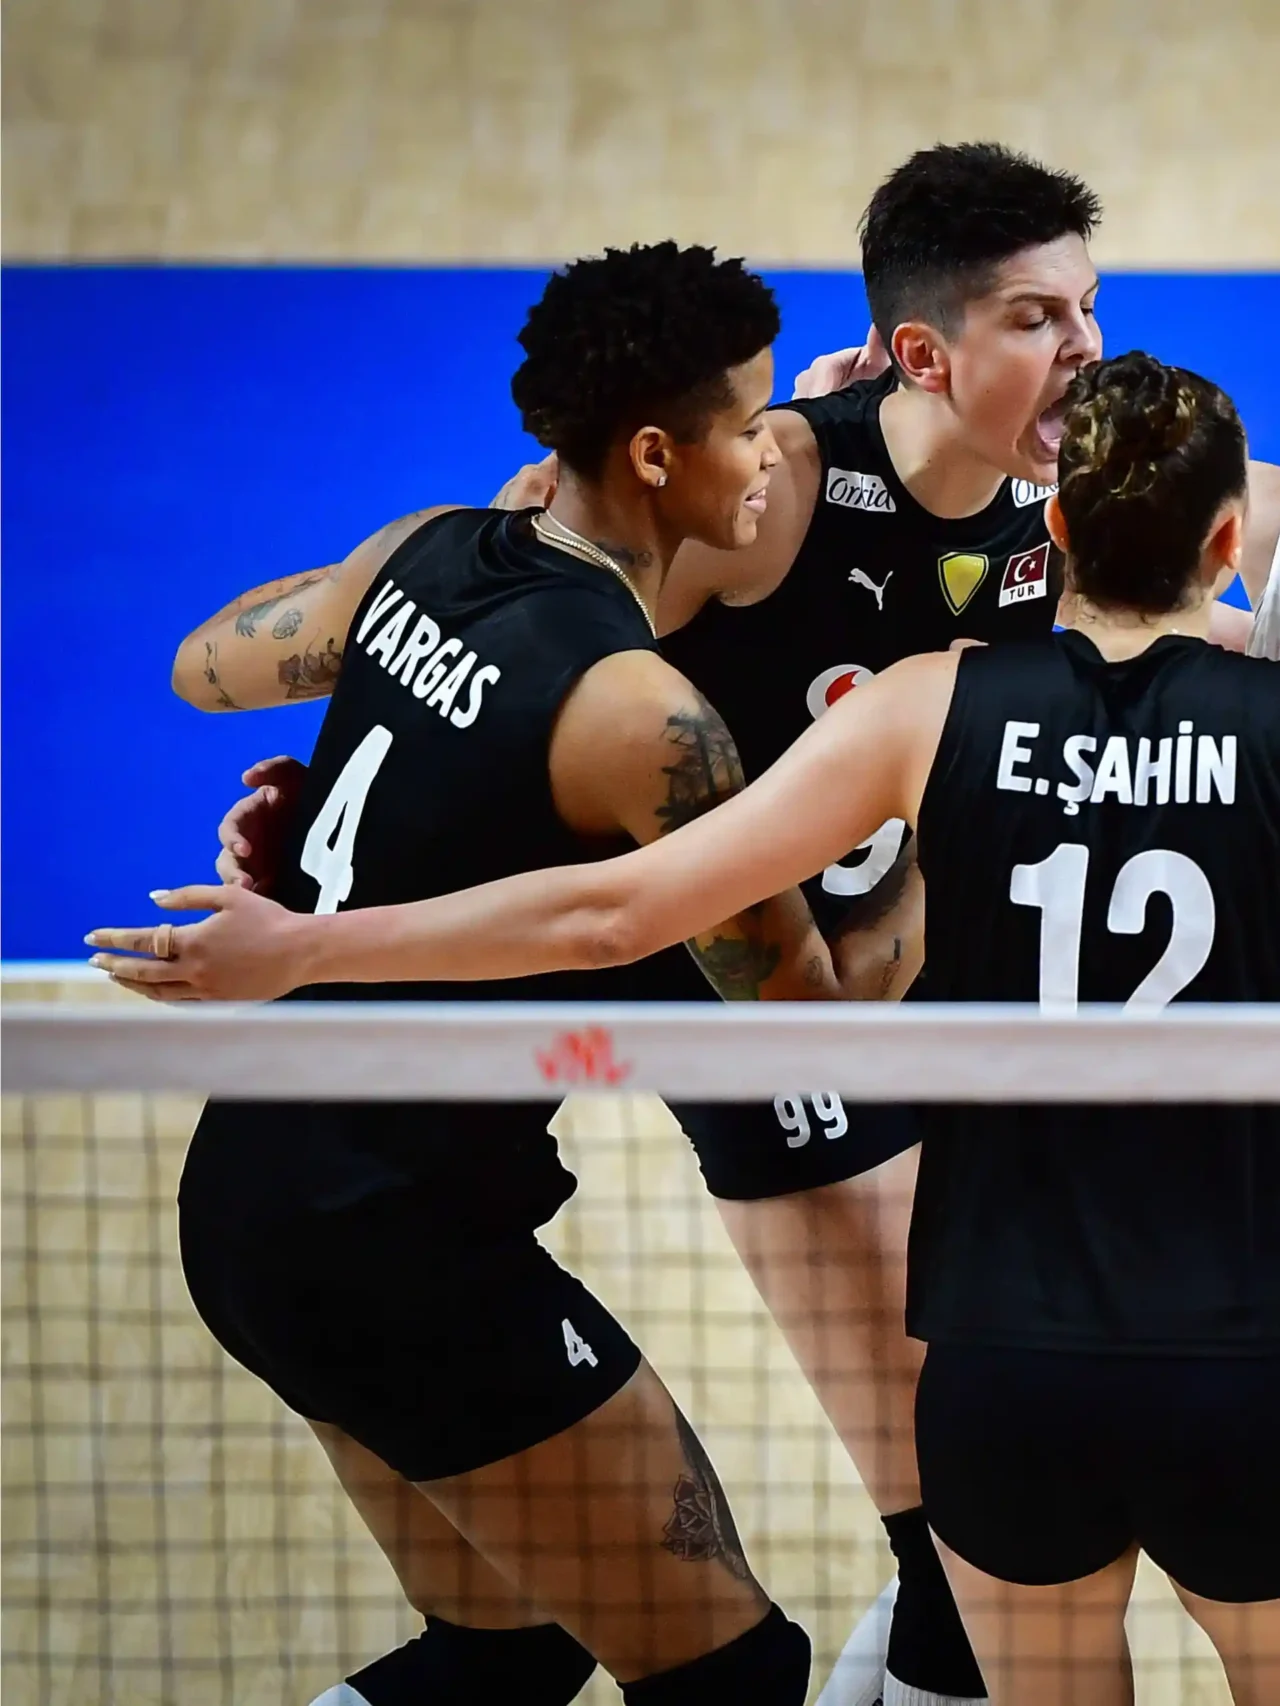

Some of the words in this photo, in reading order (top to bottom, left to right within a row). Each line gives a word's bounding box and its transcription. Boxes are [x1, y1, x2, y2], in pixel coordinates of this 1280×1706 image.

[1010, 585, 1035, 601] TUR
[356, 579, 501, 729] VARGAS
[300, 724, 393, 915] 4
[1010, 843, 1215, 1017] 12
[774, 1090, 848, 1148] 99
[562, 1318, 598, 1367] 4
